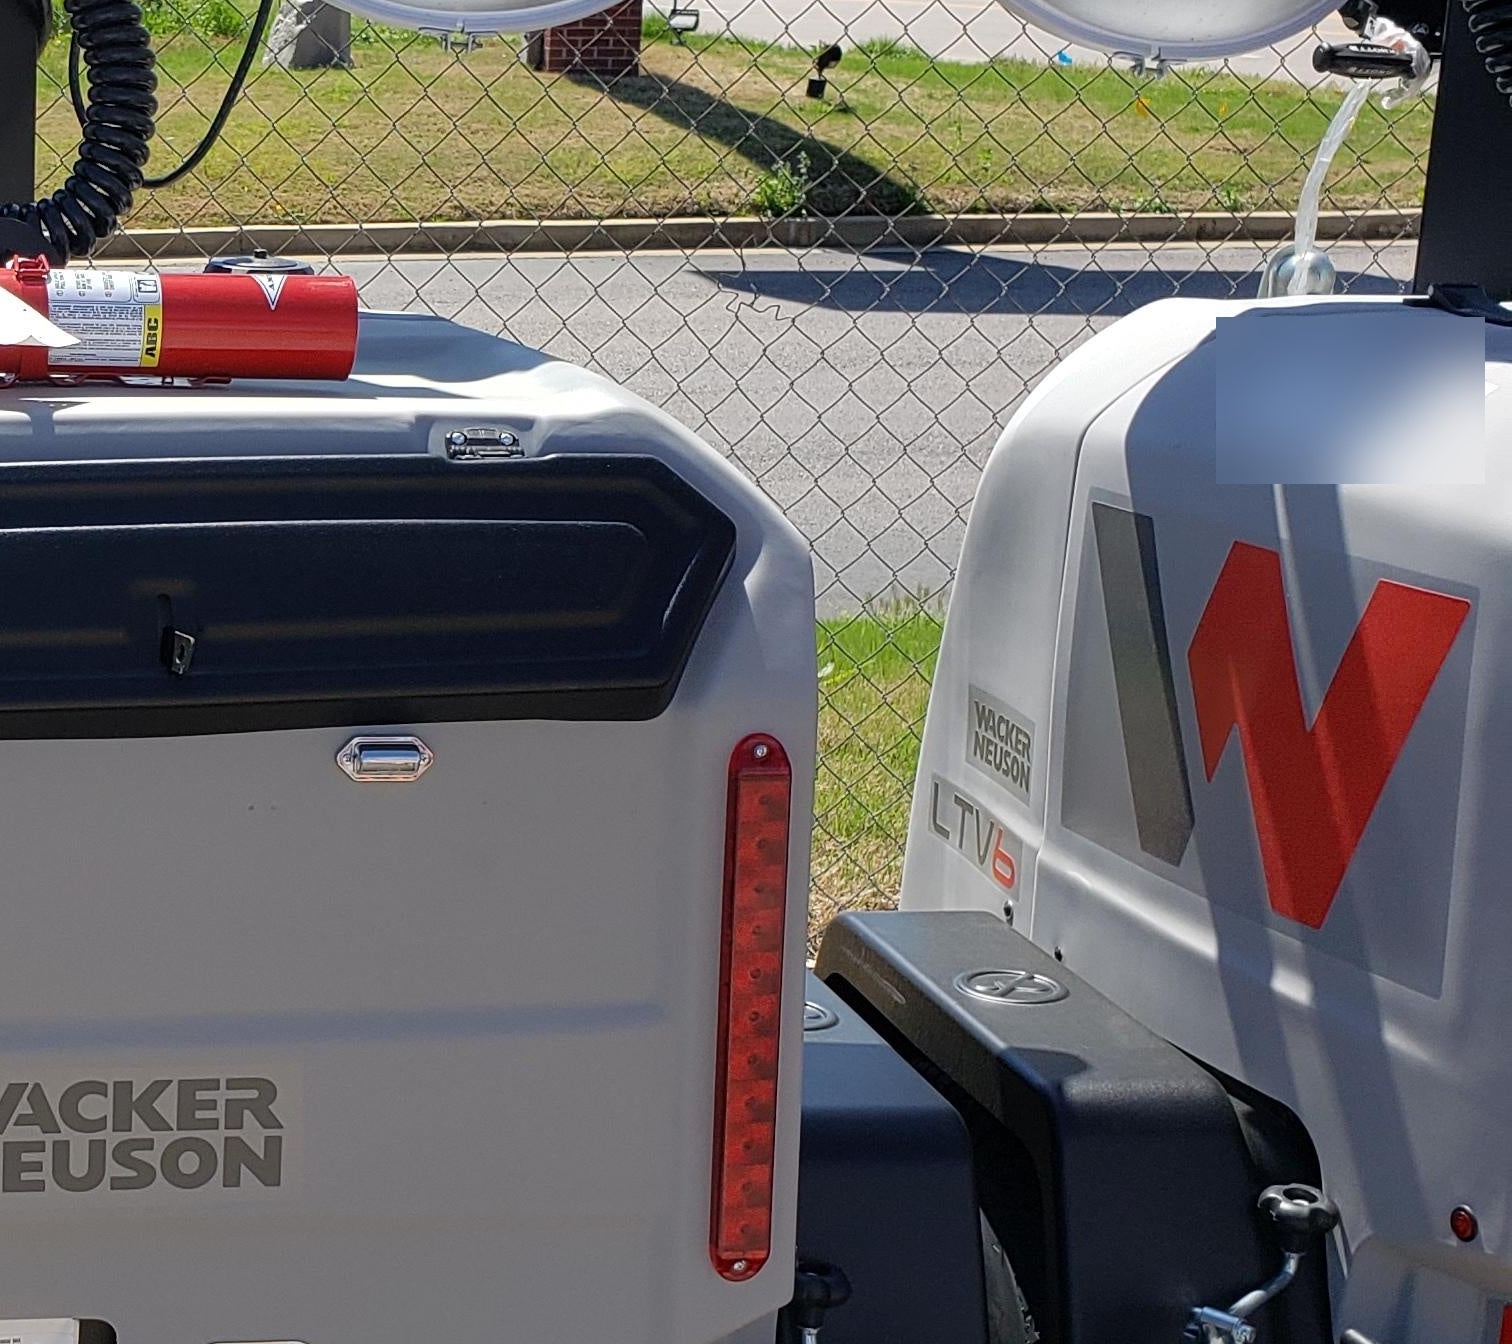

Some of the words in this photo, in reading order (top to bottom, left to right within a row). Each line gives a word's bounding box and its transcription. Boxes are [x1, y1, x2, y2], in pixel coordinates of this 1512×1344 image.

[144, 317, 159, 359] ABC
[973, 729, 1031, 794] NEUSON
[974, 700, 1032, 763] WACKER
[932, 781, 1017, 890] LTV6
